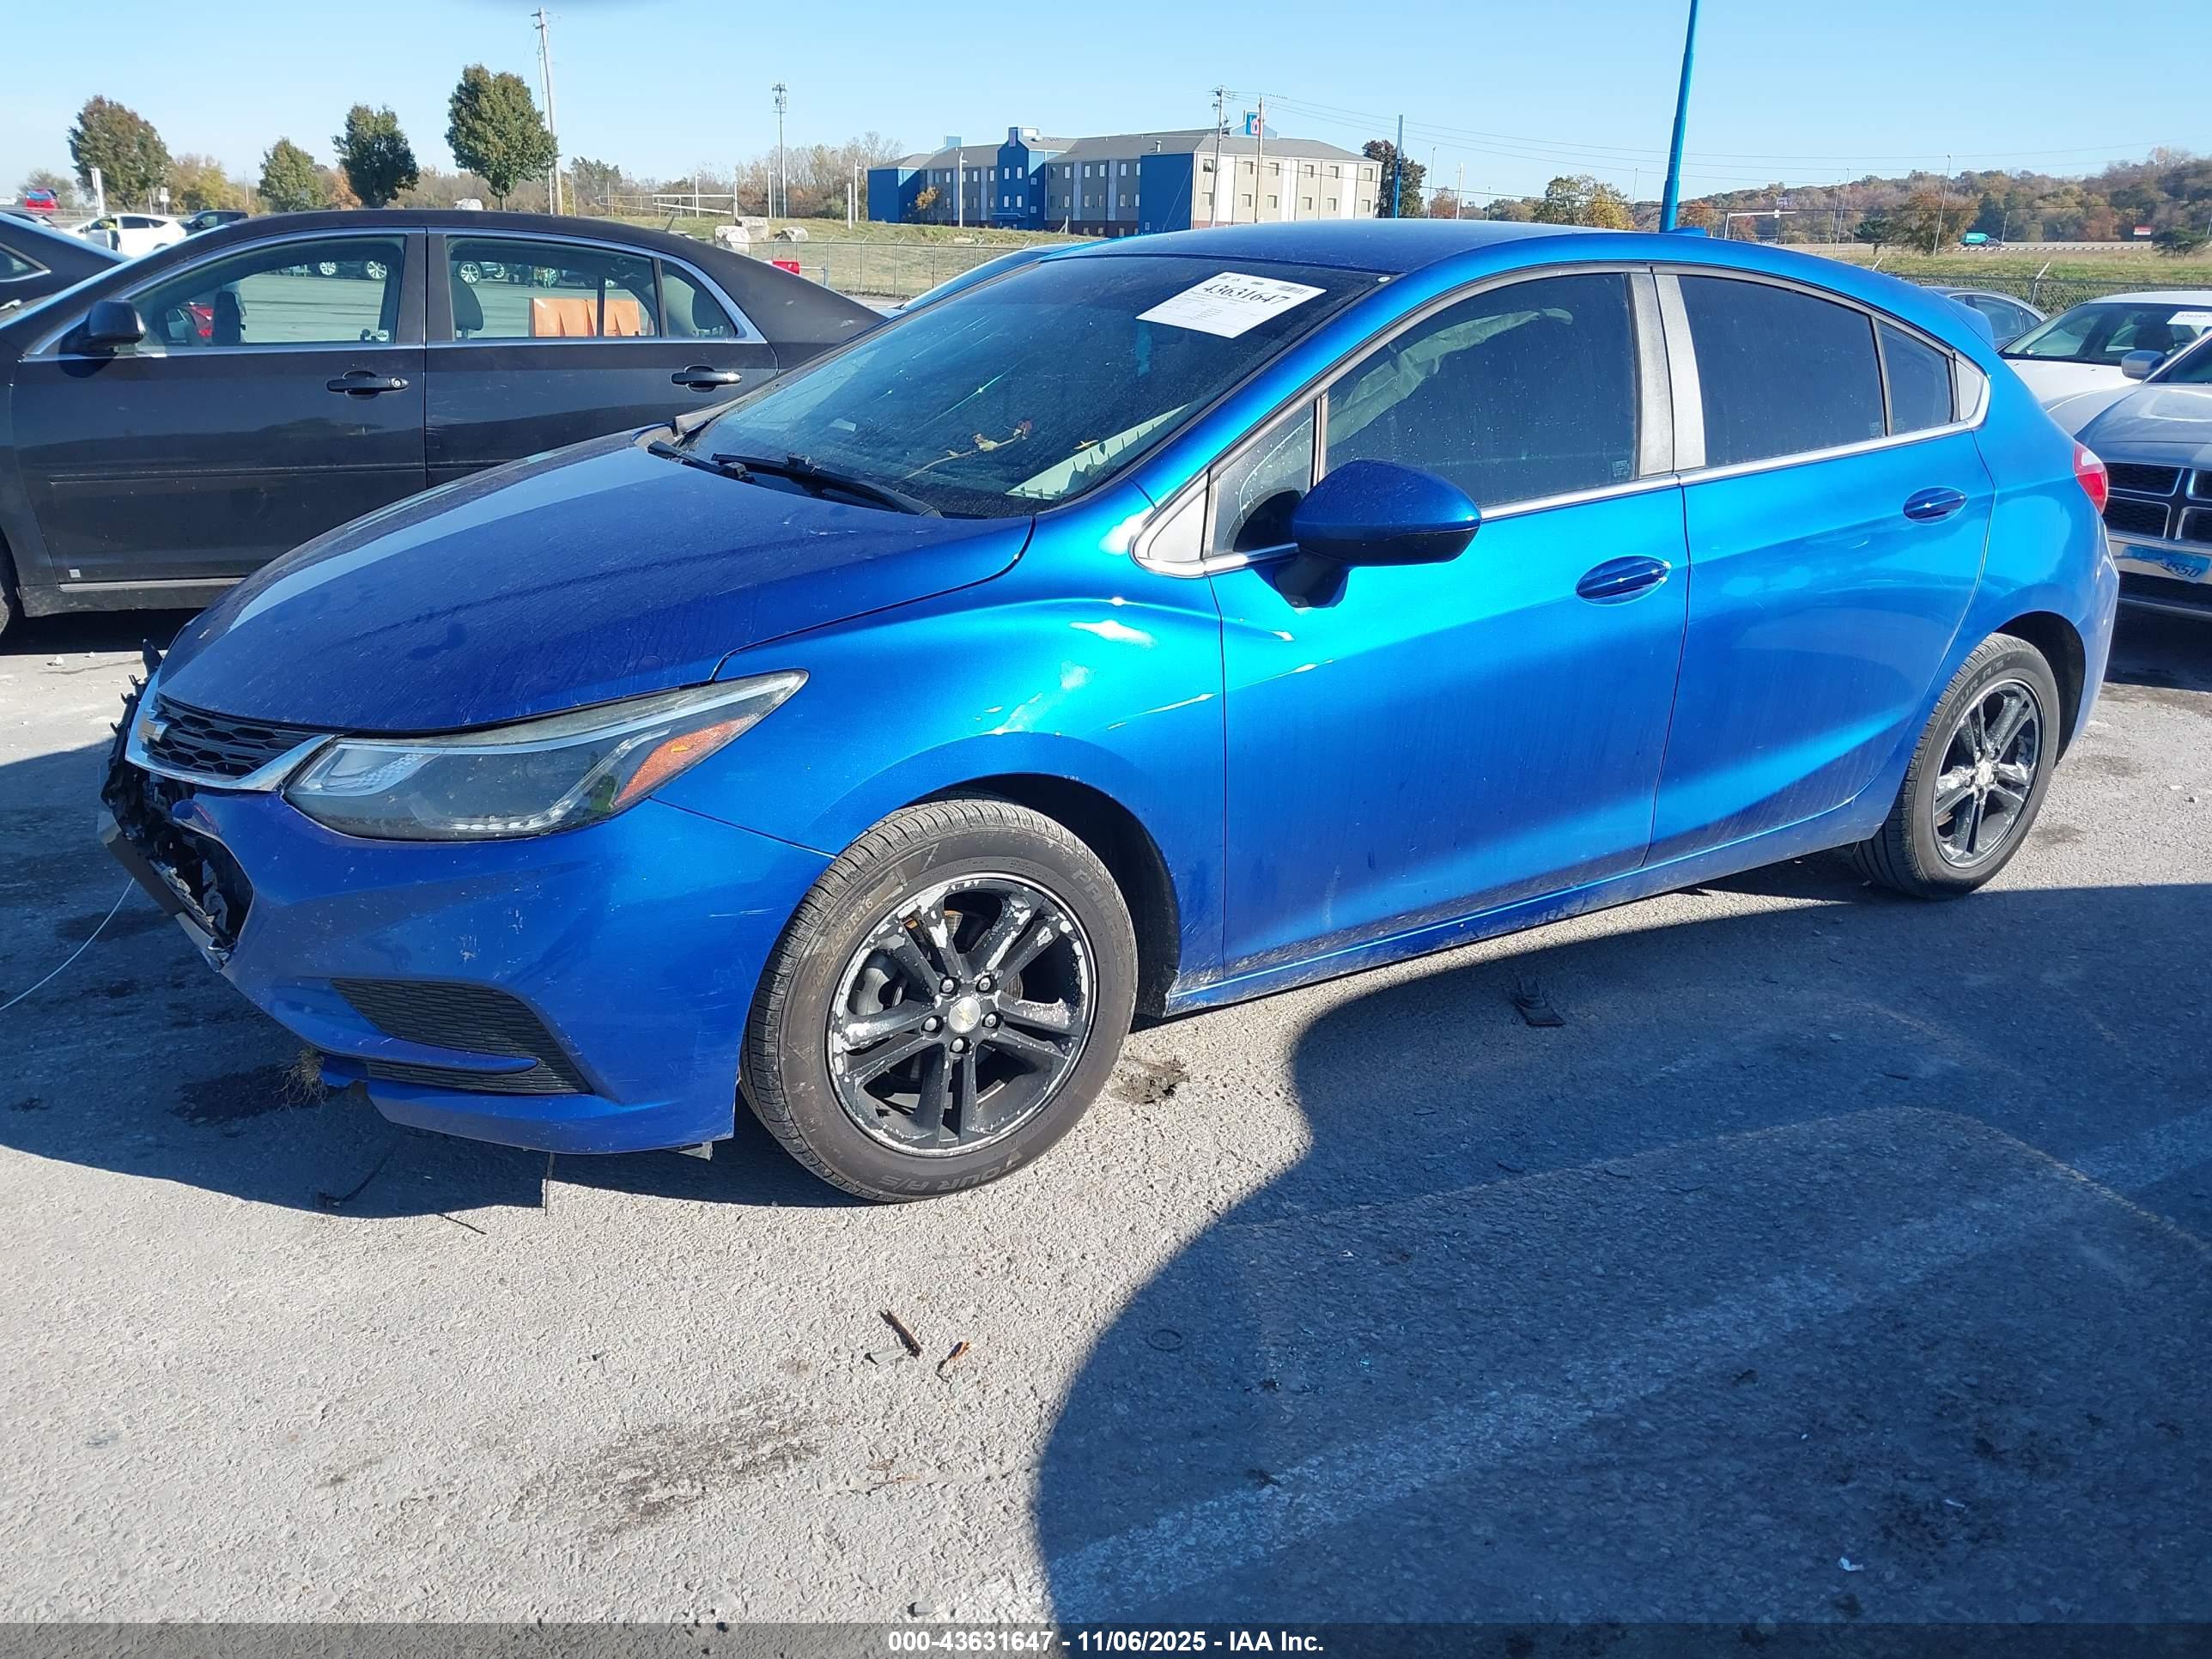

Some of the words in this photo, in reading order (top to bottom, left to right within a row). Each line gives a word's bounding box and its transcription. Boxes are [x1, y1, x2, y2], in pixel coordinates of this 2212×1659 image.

[1202, 284, 1291, 305] 43631647
[1946, 678, 1978, 724] TOUR
[878, 1175, 929, 1192] A/S
[936, 1158, 1018, 1191] TOUR
